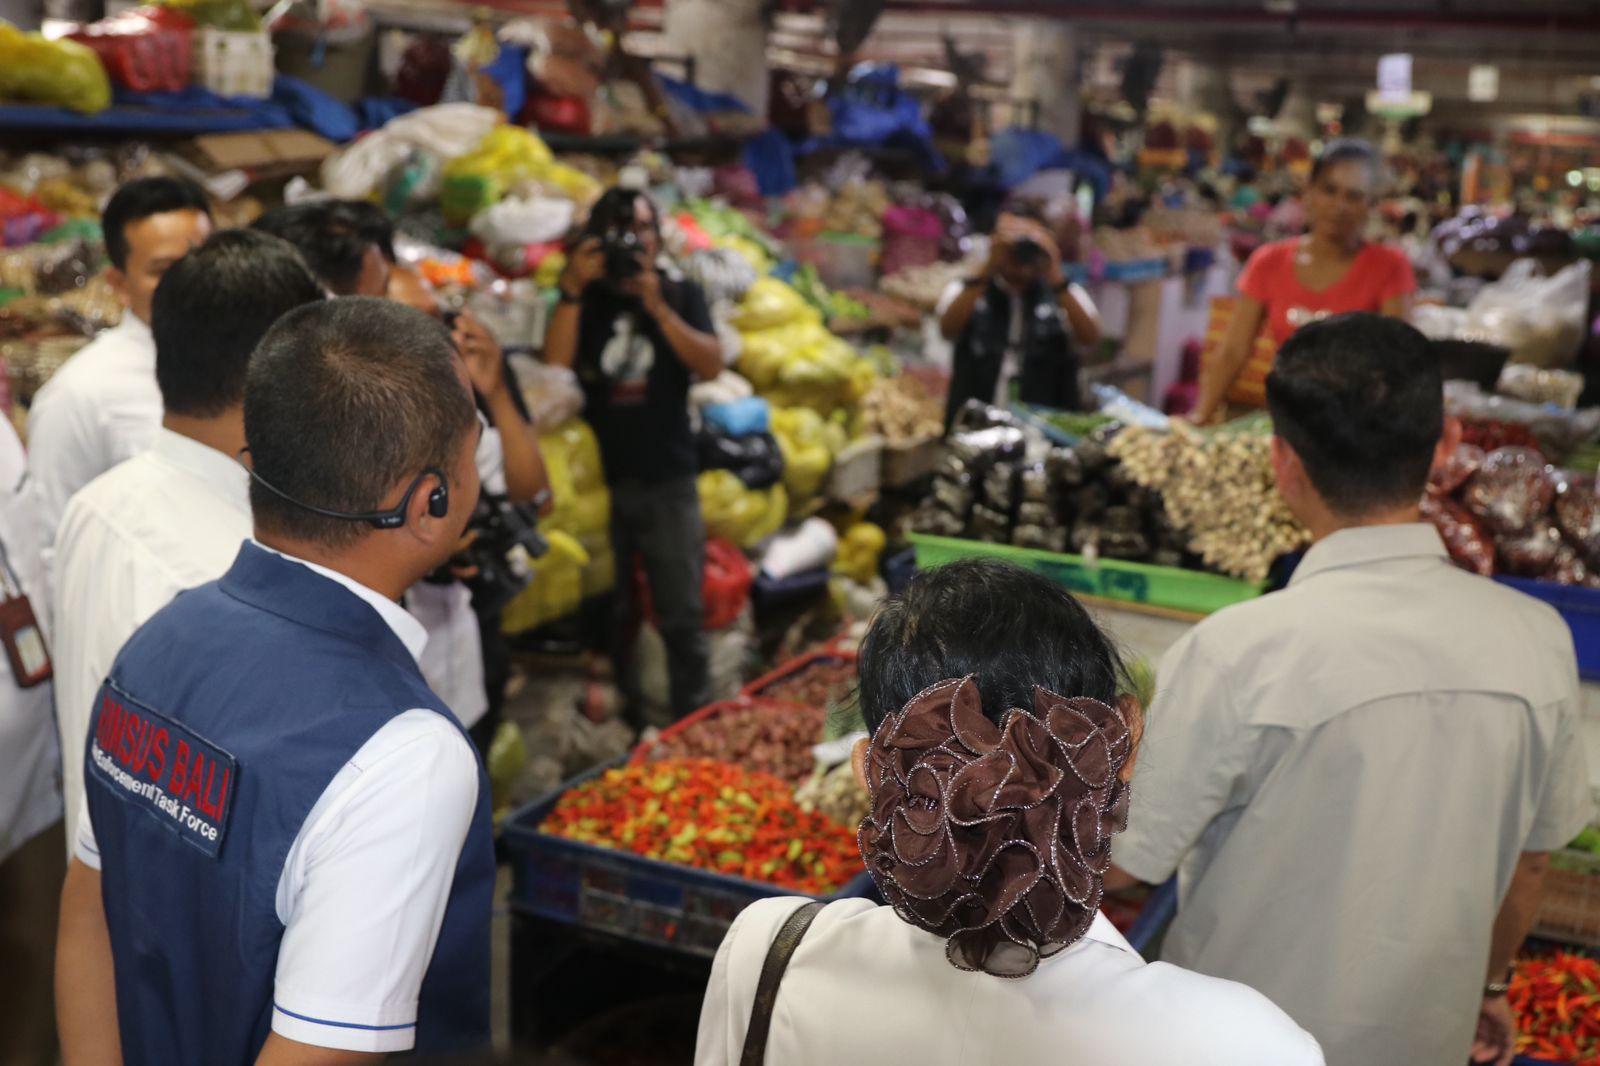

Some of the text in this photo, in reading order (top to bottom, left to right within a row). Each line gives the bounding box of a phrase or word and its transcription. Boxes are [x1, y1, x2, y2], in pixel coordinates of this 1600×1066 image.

[153, 786, 180, 820] Task
[178, 804, 218, 841] Force
[168, 738, 229, 823] BALI
